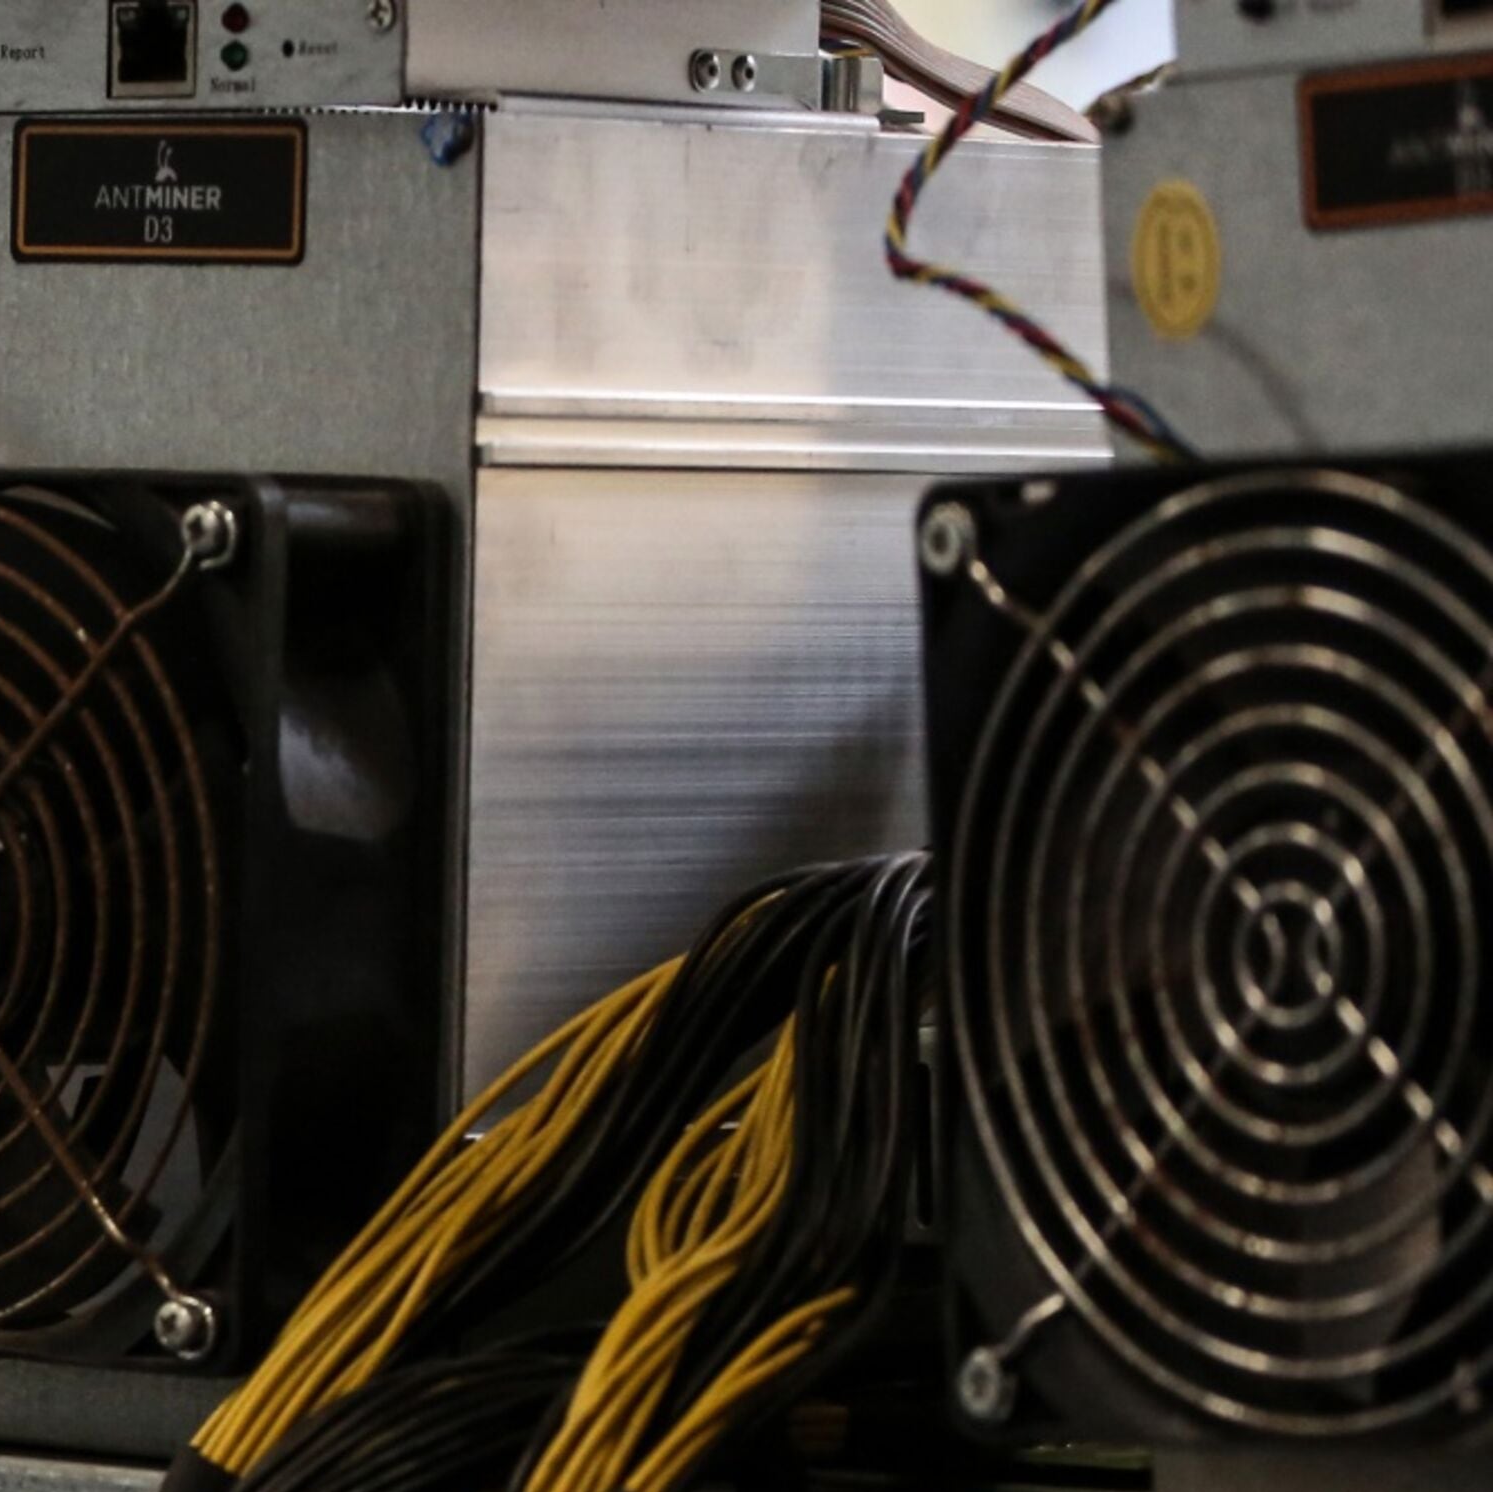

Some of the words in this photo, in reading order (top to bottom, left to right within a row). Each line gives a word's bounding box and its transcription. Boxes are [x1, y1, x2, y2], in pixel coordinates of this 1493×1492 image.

[0, 44, 44, 61] Report
[211, 77, 255, 93] Normal
[94, 184, 221, 210] ANTMINER
[144, 215, 173, 243] D3
